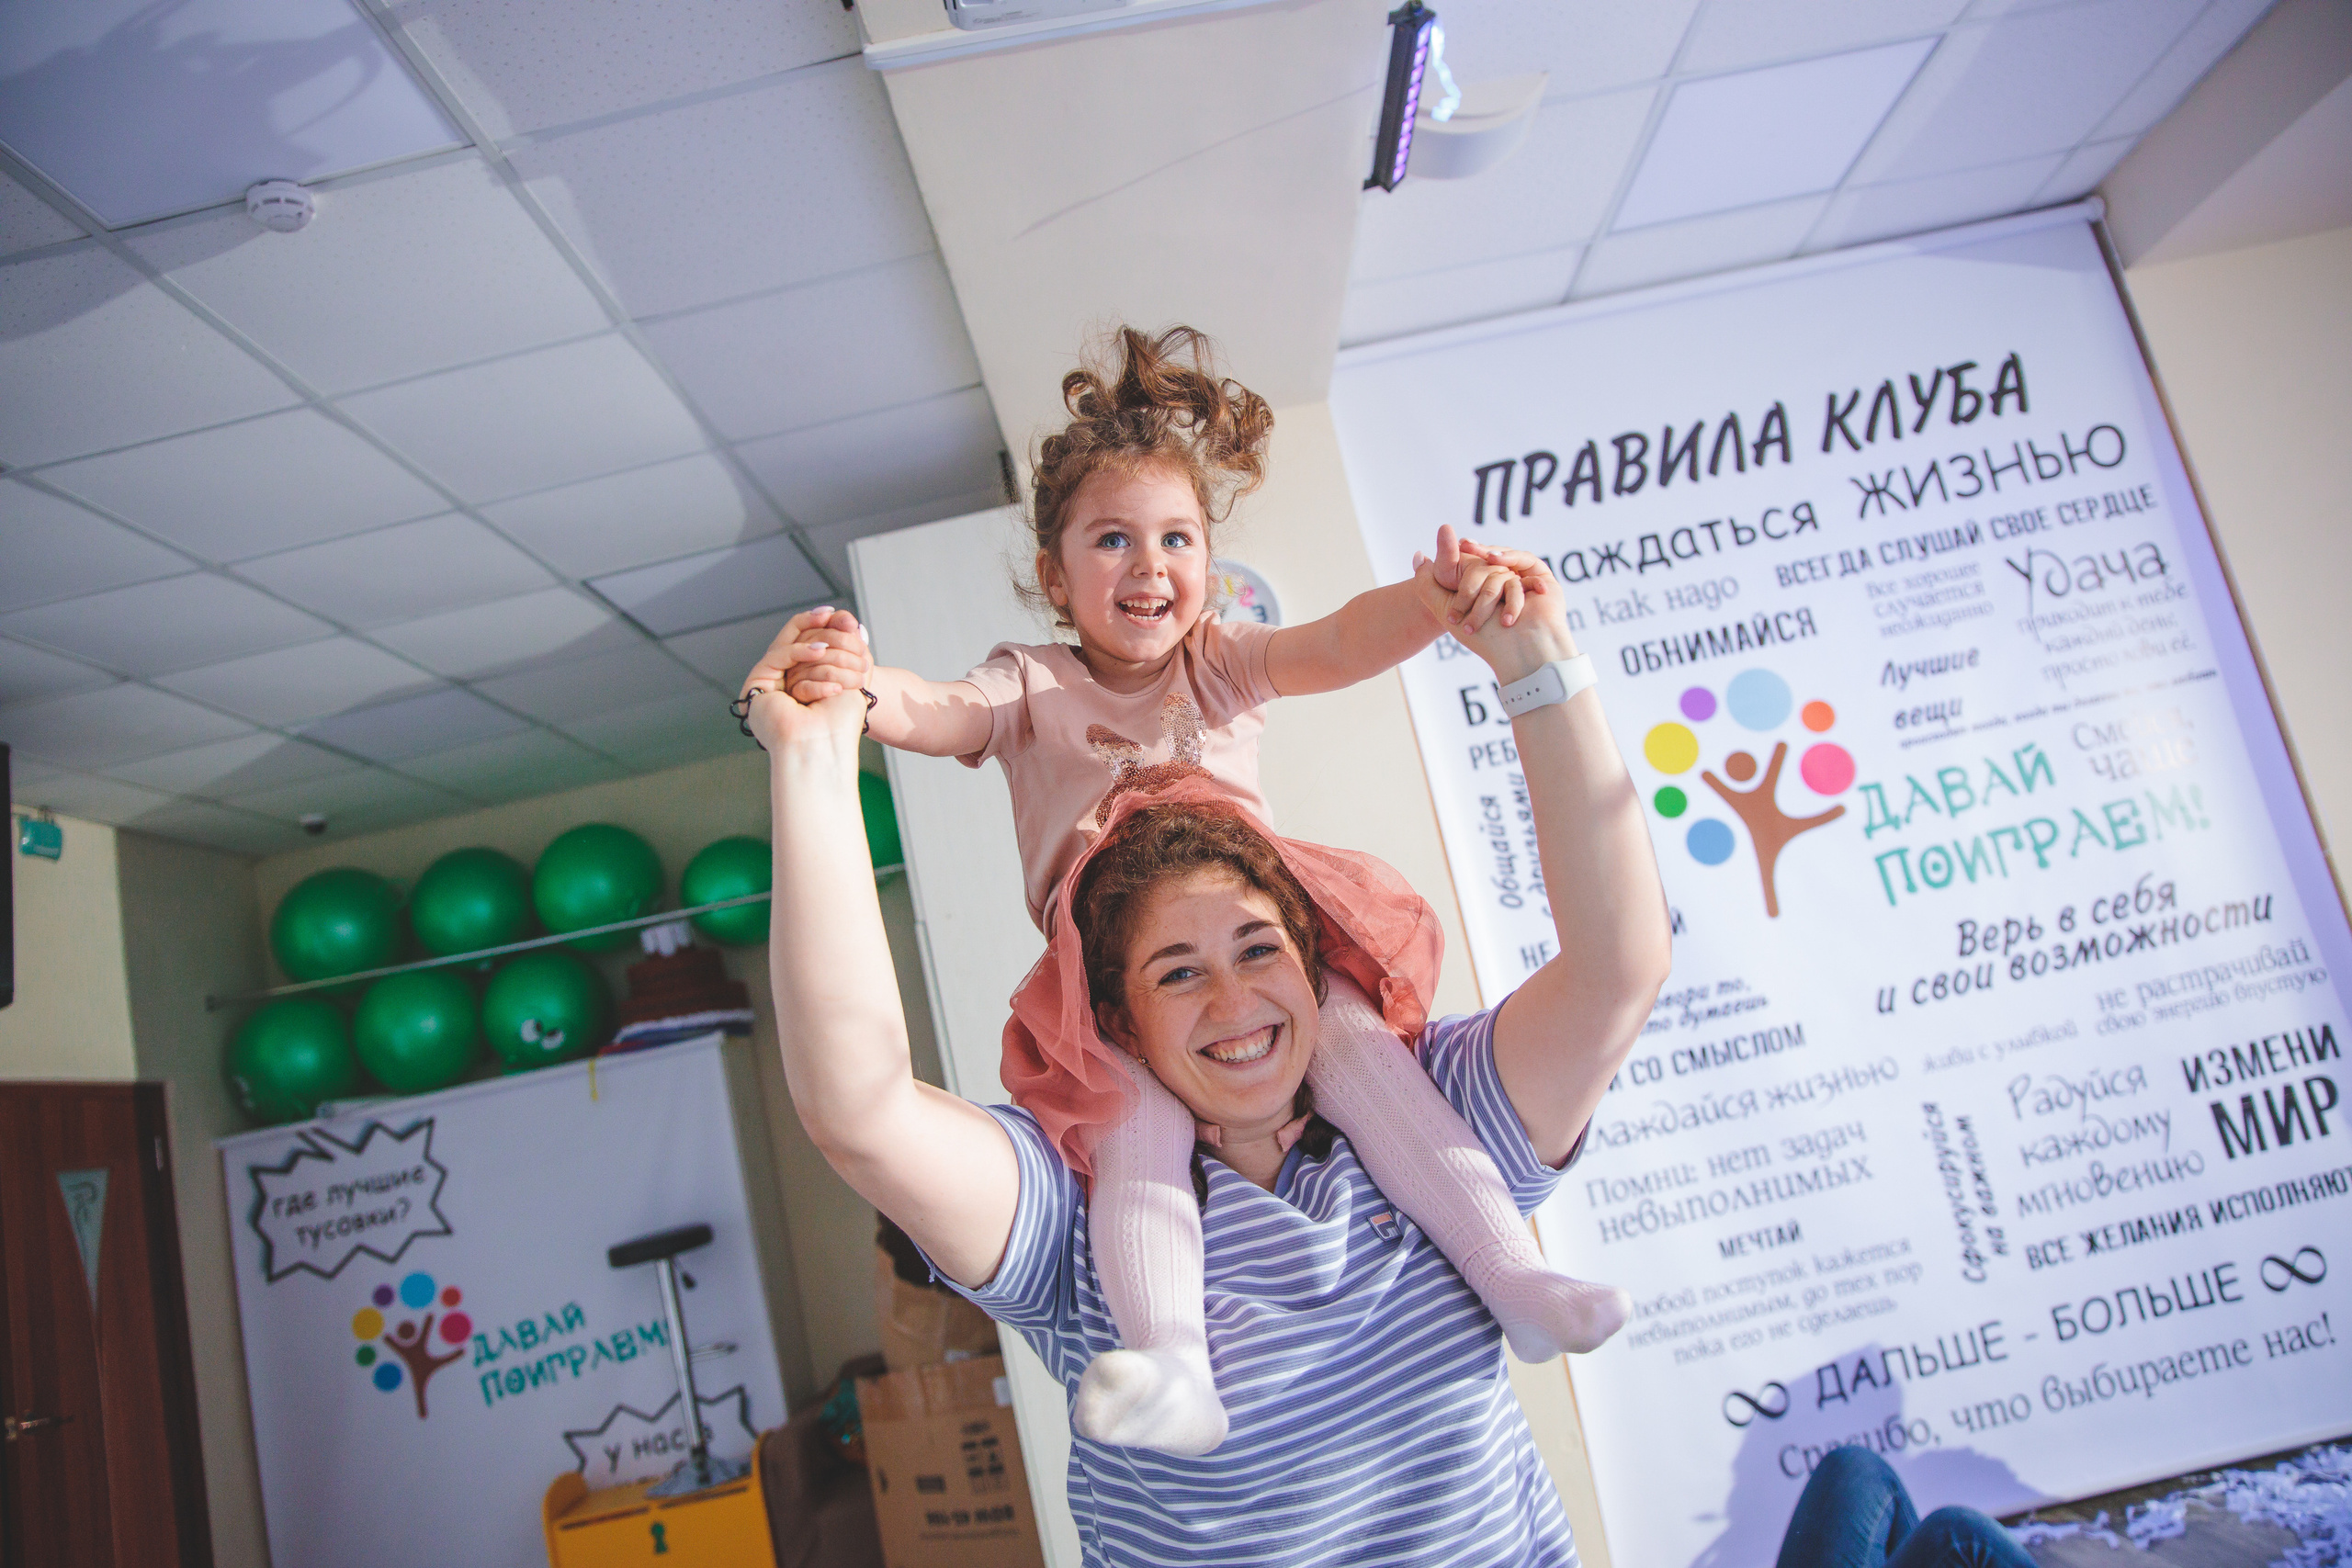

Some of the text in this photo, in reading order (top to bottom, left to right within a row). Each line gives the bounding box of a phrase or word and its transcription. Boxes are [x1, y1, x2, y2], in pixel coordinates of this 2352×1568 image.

[1473, 352, 2029, 525] ПРАВИЛА КЛУБА
[1849, 424, 2126, 519] ЖИЗНЬЮ
[1775, 483, 2158, 588] ВСЕГДА СЛУШАЙ СВОЕ СЕРДЦЕ
[1594, 589, 1656, 626] как
[1665, 576, 1739, 610] надо
[2005, 541, 2169, 625] Удача
[1621, 606, 1819, 676] ОБНИМАЙСЯ
[1880, 647, 1980, 689] Лучшие
[1894, 697, 1962, 729] вещи
[1858, 742, 2055, 839] ДАВАЙ
[1480, 795, 1523, 909] Общайся
[1874, 784, 2211, 907] ПОИГРАЕМ!
[1957, 871, 2178, 958] Верь в себя
[1877, 894, 2274, 1014] и свои возможности
[2095, 937, 2312, 1011] не растрачивай
[2234, 966, 2327, 1004] впустую
[1679, 995, 1769, 1030] думаешь
[1630, 1055, 1663, 1086] СО
[1671, 1022, 1805, 1076] СМЫСЛОМ
[1763, 1055, 1899, 1111] жизнью
[2181, 1021, 2341, 1094] ИЗМЕНИ
[2007, 1064, 2148, 1122] Радуйся
[2210, 1074, 2339, 1159] МИР
[1706, 1143, 1770, 1178] нет
[1780, 1120, 1867, 1161] задач
[2020, 1108, 2171, 1167] каждому
[1598, 1155, 1875, 1244] невыполнимых
[1922, 1102, 1988, 1283] Сфокусируйся
[1956, 1115, 2008, 1256] на важном
[2018, 1149, 2205, 1218] мгновению
[1719, 1219, 1804, 1259] МЕЧТАЙ
[2025, 1235, 2074, 1271] ВСЕ
[2084, 1202, 2203, 1258] ЖЕЛАНИЯ
[472, 1300, 586, 1369] ДАВАЙ
[1816, 1320, 2008, 1411] ДАЛЬШЕ
[2051, 1261, 2243, 1343] БОЛЬШЕ
[1950, 1392, 2031, 1433] что
[2040, 1338, 2253, 1413] выбираете
[2261, 1310, 2336, 1359] нас!
